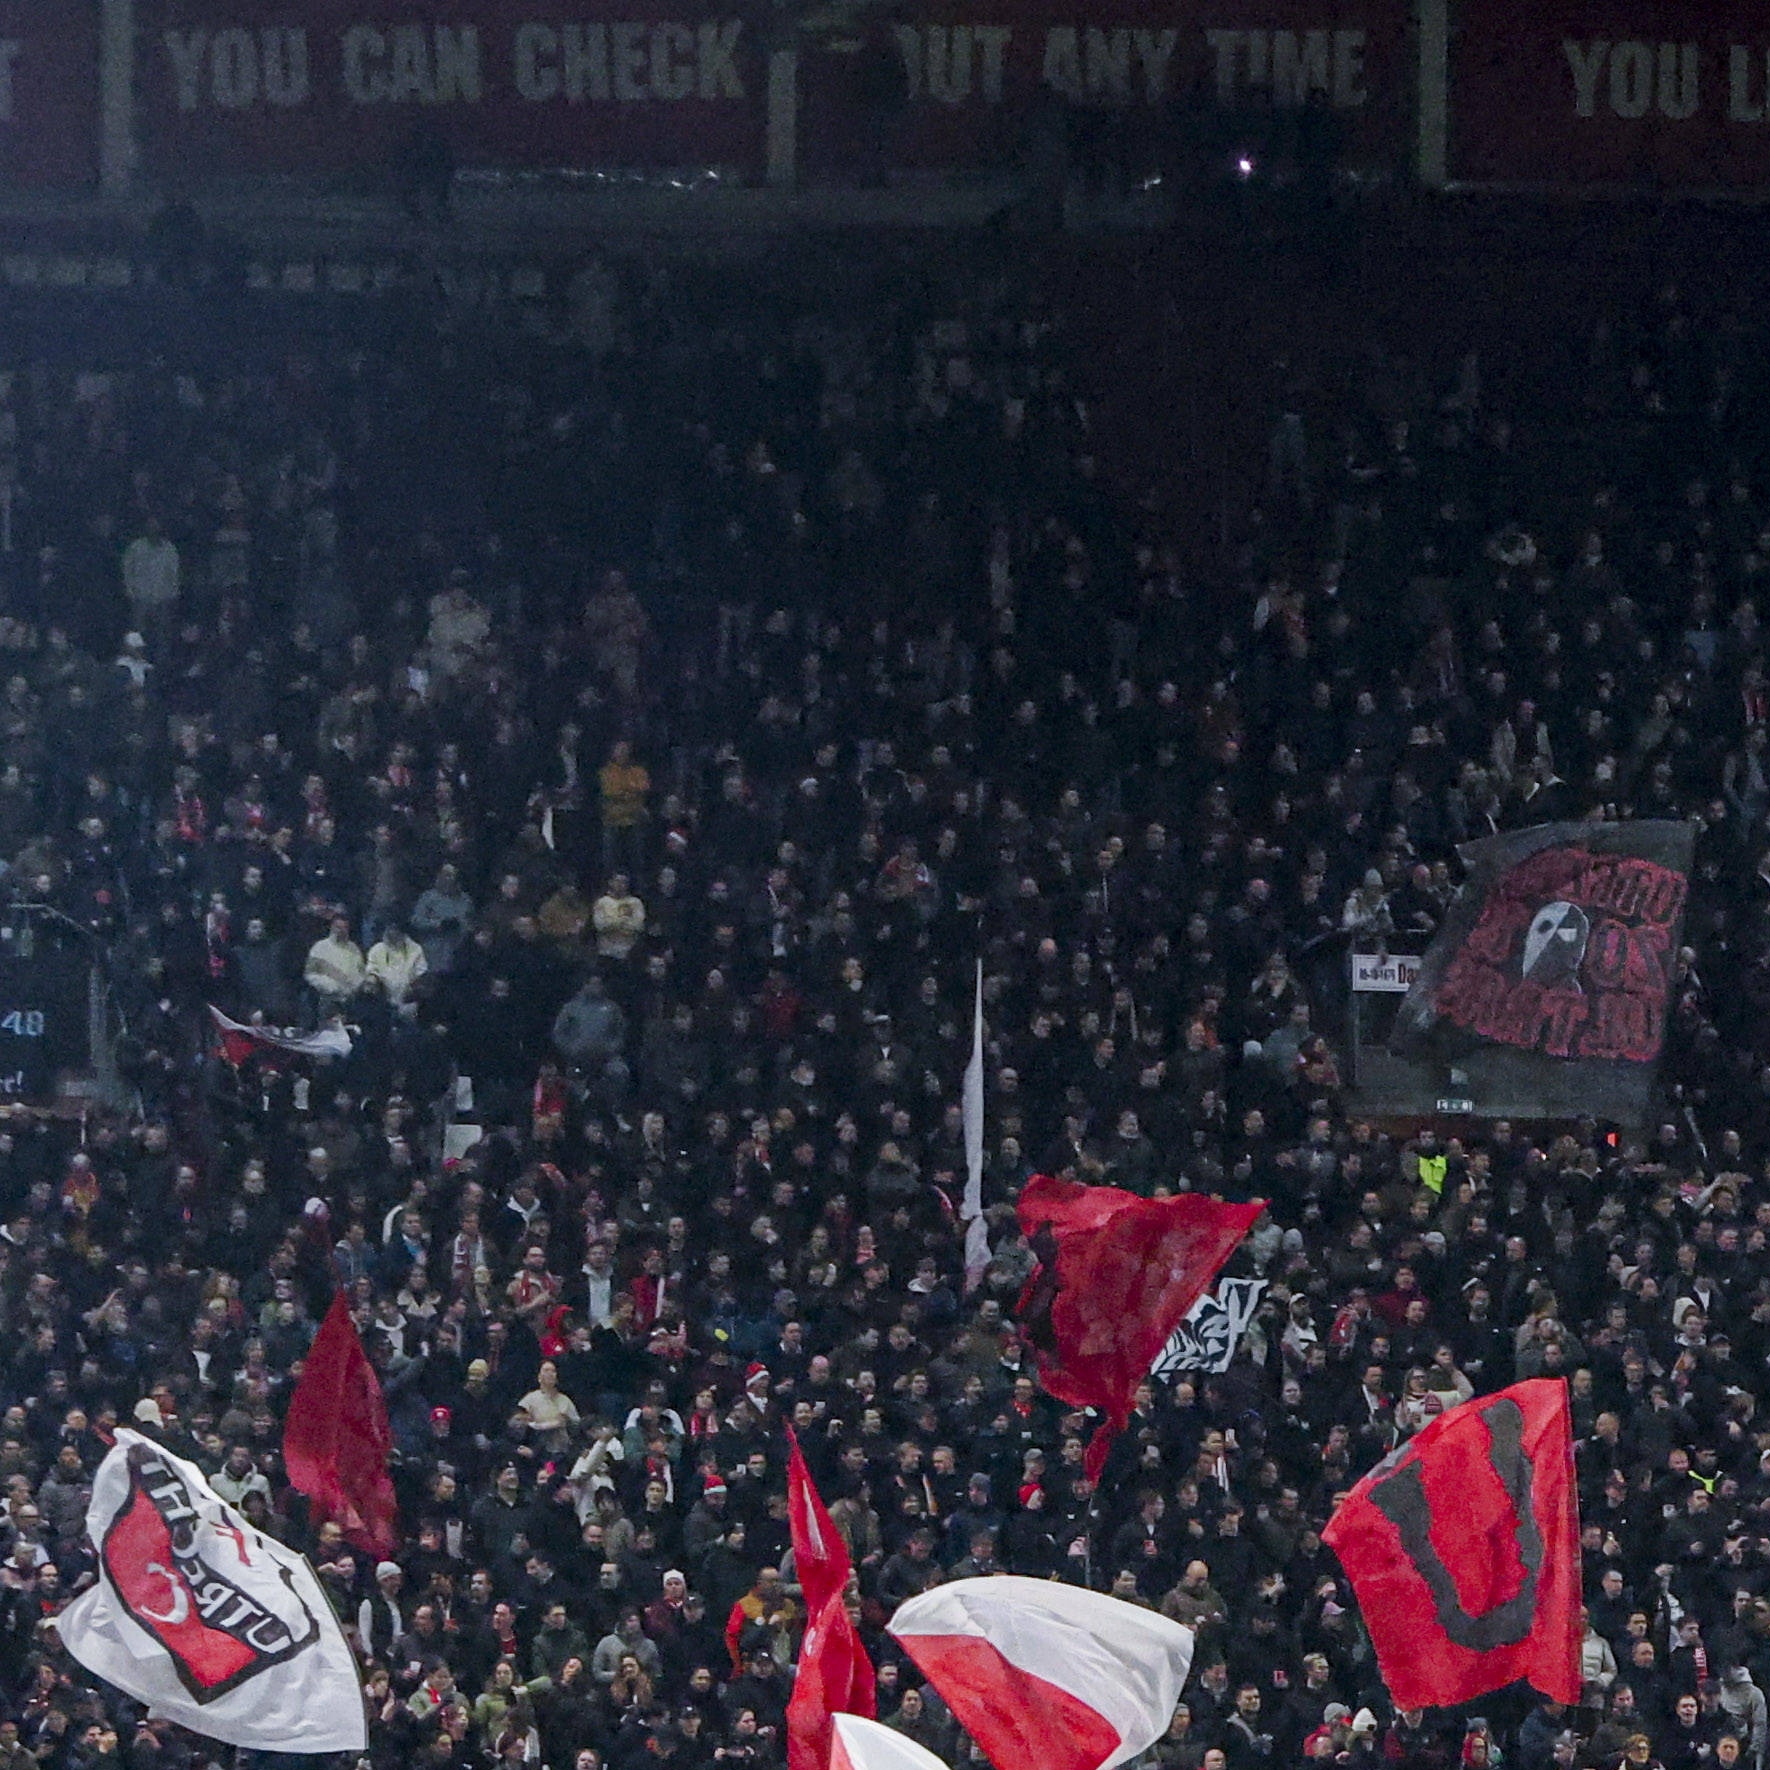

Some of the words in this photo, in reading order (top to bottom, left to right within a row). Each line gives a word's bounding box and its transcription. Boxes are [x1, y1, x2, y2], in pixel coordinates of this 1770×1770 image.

[164, 26, 309, 108] YOU
[342, 23, 481, 102] CAN
[514, 19, 745, 101] CHECK
[1042, 28, 1178, 100] ANY
[1206, 29, 1368, 104] TIME
[1563, 40, 1699, 119] YOU
